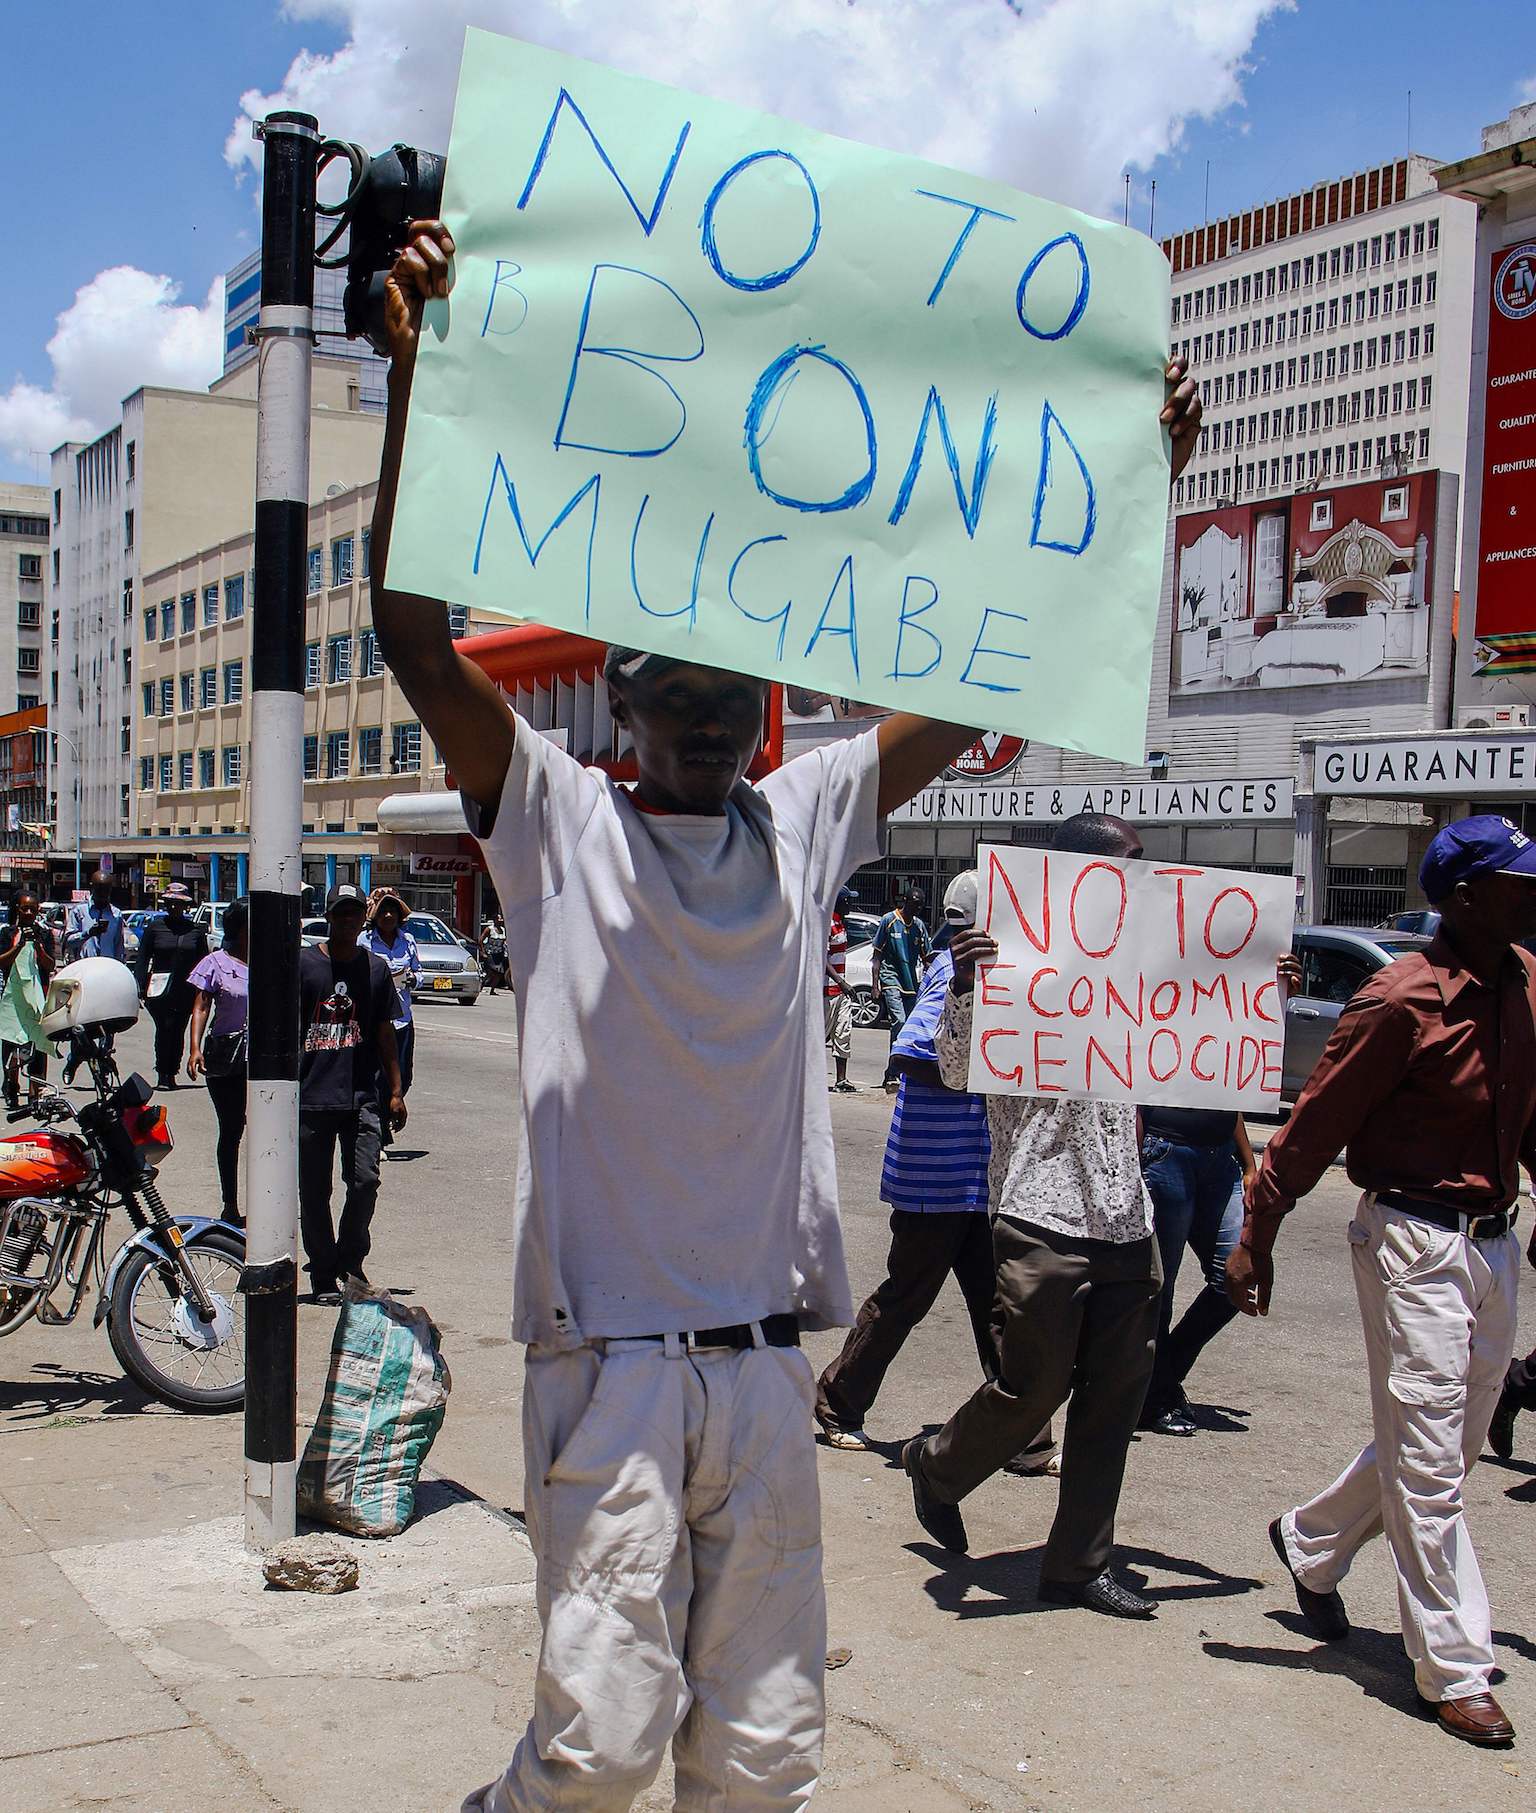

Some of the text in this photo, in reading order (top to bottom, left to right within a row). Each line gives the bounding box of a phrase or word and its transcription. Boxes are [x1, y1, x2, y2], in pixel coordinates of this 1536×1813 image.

[518, 87, 1091, 340] NO TO
[481, 260, 1098, 556] B BOND
[1509, 505, 1517, 516] &
[473, 453, 1031, 694] MUGABE
[1486, 546, 1536, 563] APPLIANCES
[956, 759, 985, 769] HOME
[1325, 747, 1536, 783] GUARANTE
[909, 784, 1277, 817] FURNITURE & APPLIANCES
[415, 856, 469, 871] Bata
[985, 849, 1259, 960] NO TO
[978, 963, 1278, 1028] ECONOMIC
[980, 1028, 1282, 1092] GENOCIDE
